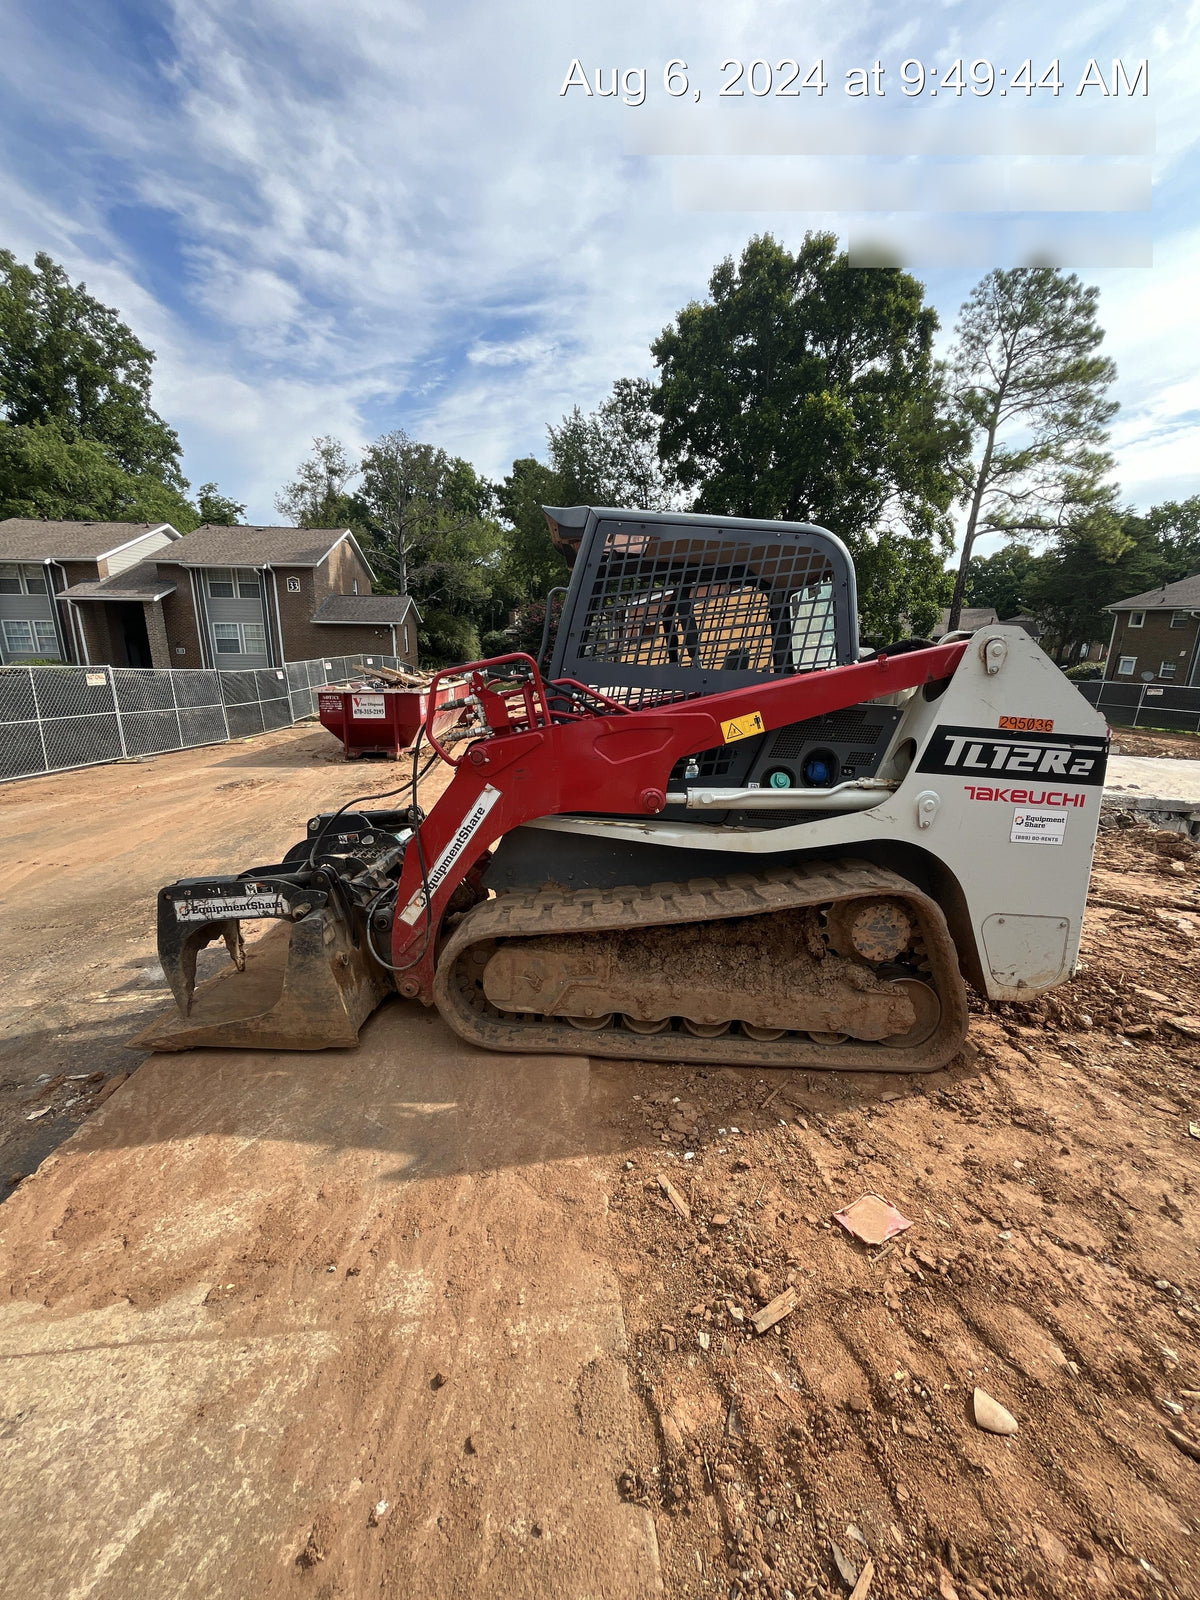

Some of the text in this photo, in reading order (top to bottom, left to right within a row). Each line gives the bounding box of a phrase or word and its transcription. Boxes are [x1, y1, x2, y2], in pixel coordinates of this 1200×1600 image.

[289, 582, 299, 591] 33
[999, 716, 1053, 732] 295036
[964, 786, 1086, 808] TAKEUCHI
[1025, 815, 1065, 823] Equipment
[191, 901, 283, 916] EquipmentShare
